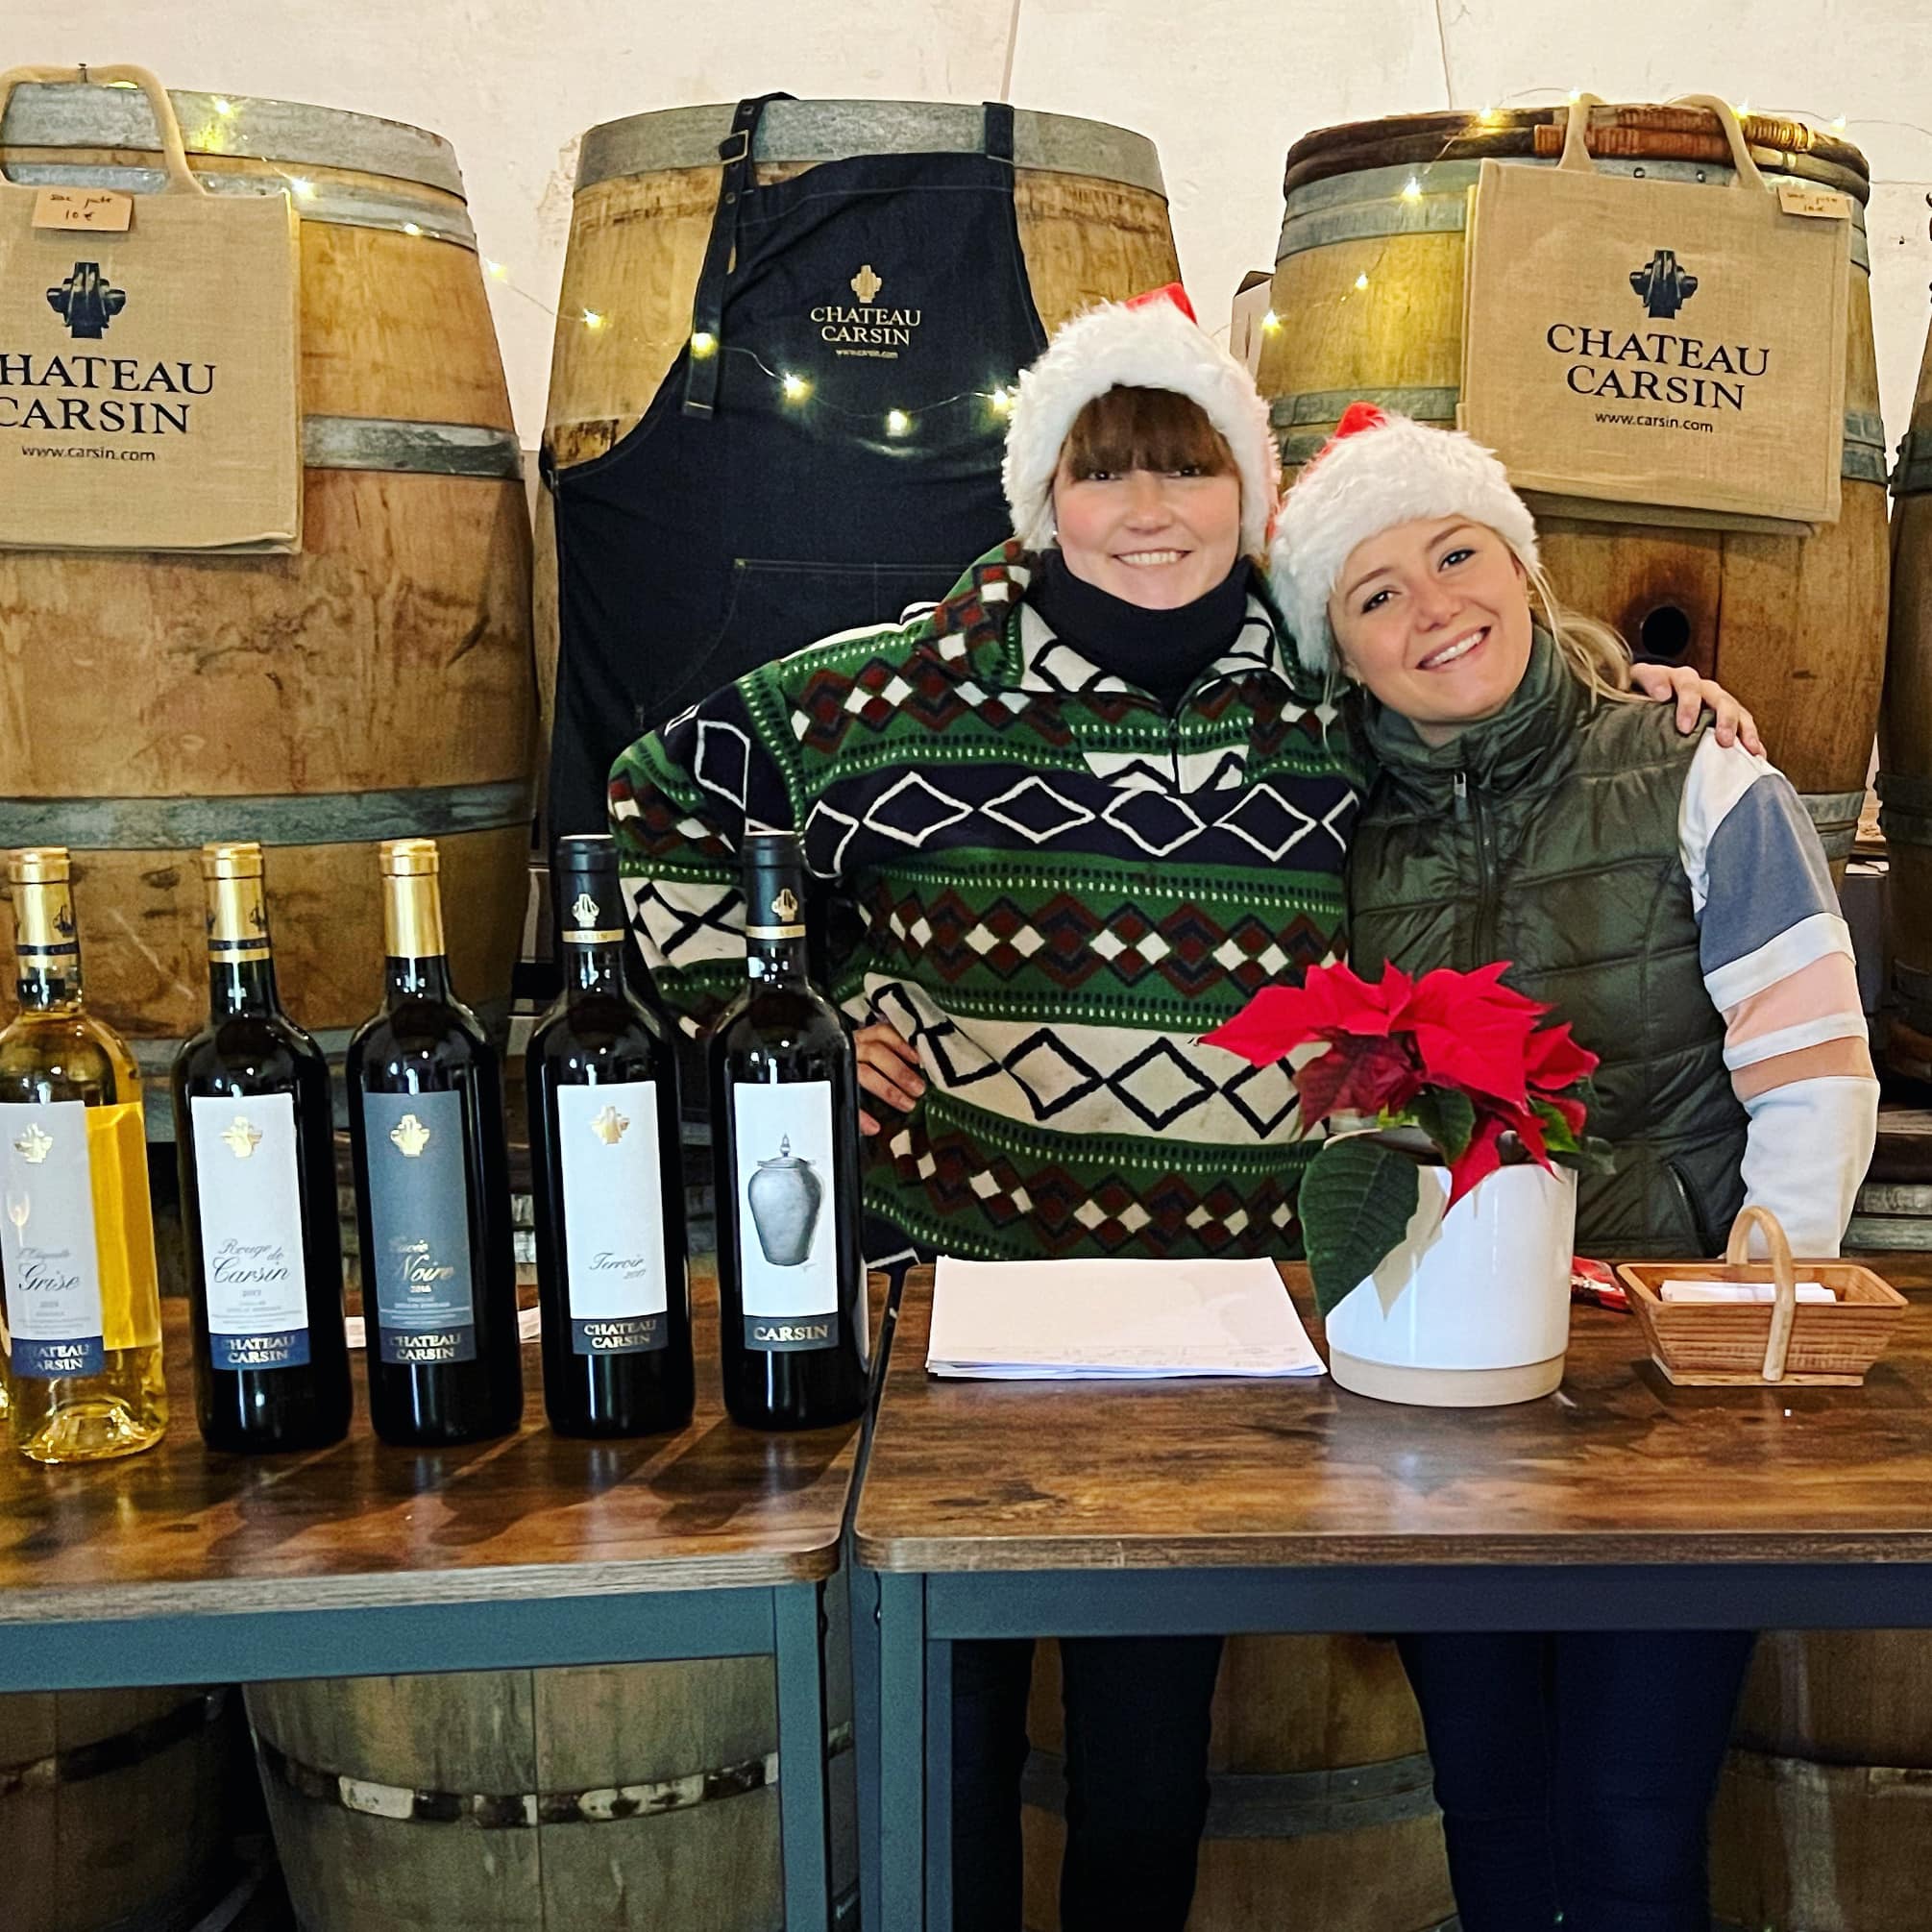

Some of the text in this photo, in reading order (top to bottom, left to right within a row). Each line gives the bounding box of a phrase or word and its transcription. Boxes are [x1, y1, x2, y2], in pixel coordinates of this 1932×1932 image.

[810, 306, 921, 327] CHATEAU
[821, 326, 910, 346] CARSIN
[1547, 324, 1770, 376] CHATEAU
[0, 354, 216, 395] HATEAU
[1566, 364, 1746, 410] CARSIN
[1595, 411, 1714, 432] www.carsin.com
[21, 445, 156, 461] www.carsin.com
[217, 1238, 272, 1259] Rouge
[211, 1256, 290, 1284] Carsin
[589, 1252, 646, 1271] Terroir
[17, 1262, 81, 1291] Grise
[583, 1319, 657, 1336] CHATEAU
[753, 1325, 829, 1342] CARSIN
[591, 1333, 650, 1349] CARSIN
[227, 1350, 289, 1364] CARSIN
[396, 1347, 454, 1361] CARSIN
